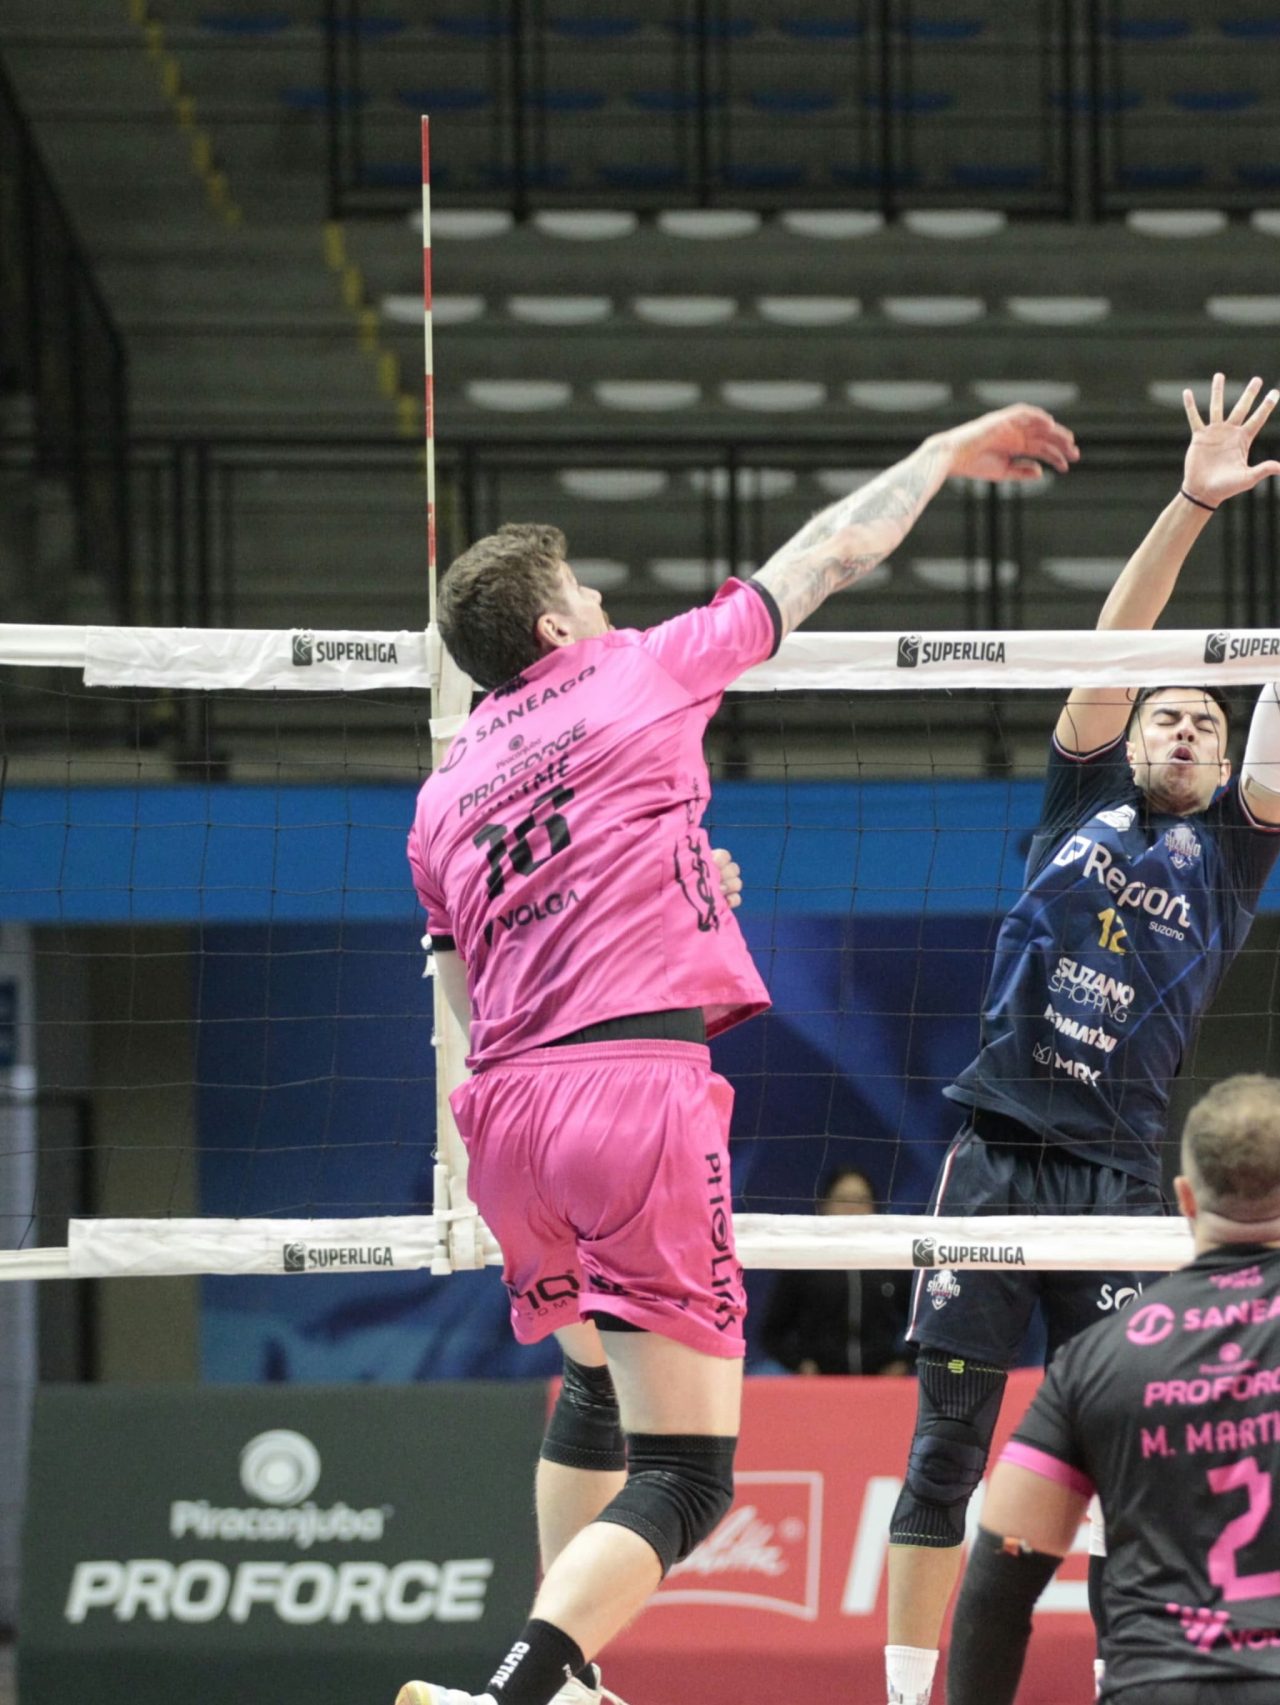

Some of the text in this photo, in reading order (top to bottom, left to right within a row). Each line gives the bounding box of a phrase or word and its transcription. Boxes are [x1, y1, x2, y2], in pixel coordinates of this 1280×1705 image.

[316, 641, 398, 664] SUPERLIGA
[921, 641, 1006, 664] SUPERLIGA
[475, 665, 596, 743] SANEAGO
[1082, 842, 1191, 929] Report
[497, 889, 580, 931] VOLGA
[1097, 907, 1128, 956] 12
[1148, 921, 1185, 942] suzano
[1047, 974, 1129, 1023] SHOPPING
[1055, 957, 1135, 1005] SUZANO
[308, 1246, 394, 1268] SUPERLIGA
[938, 1244, 1025, 1266] SUPERLIGA
[1141, 1427, 1176, 1458] M.
[168, 1500, 386, 1550] Piracanjuba
[64, 1557, 496, 1625] PROFORCE
